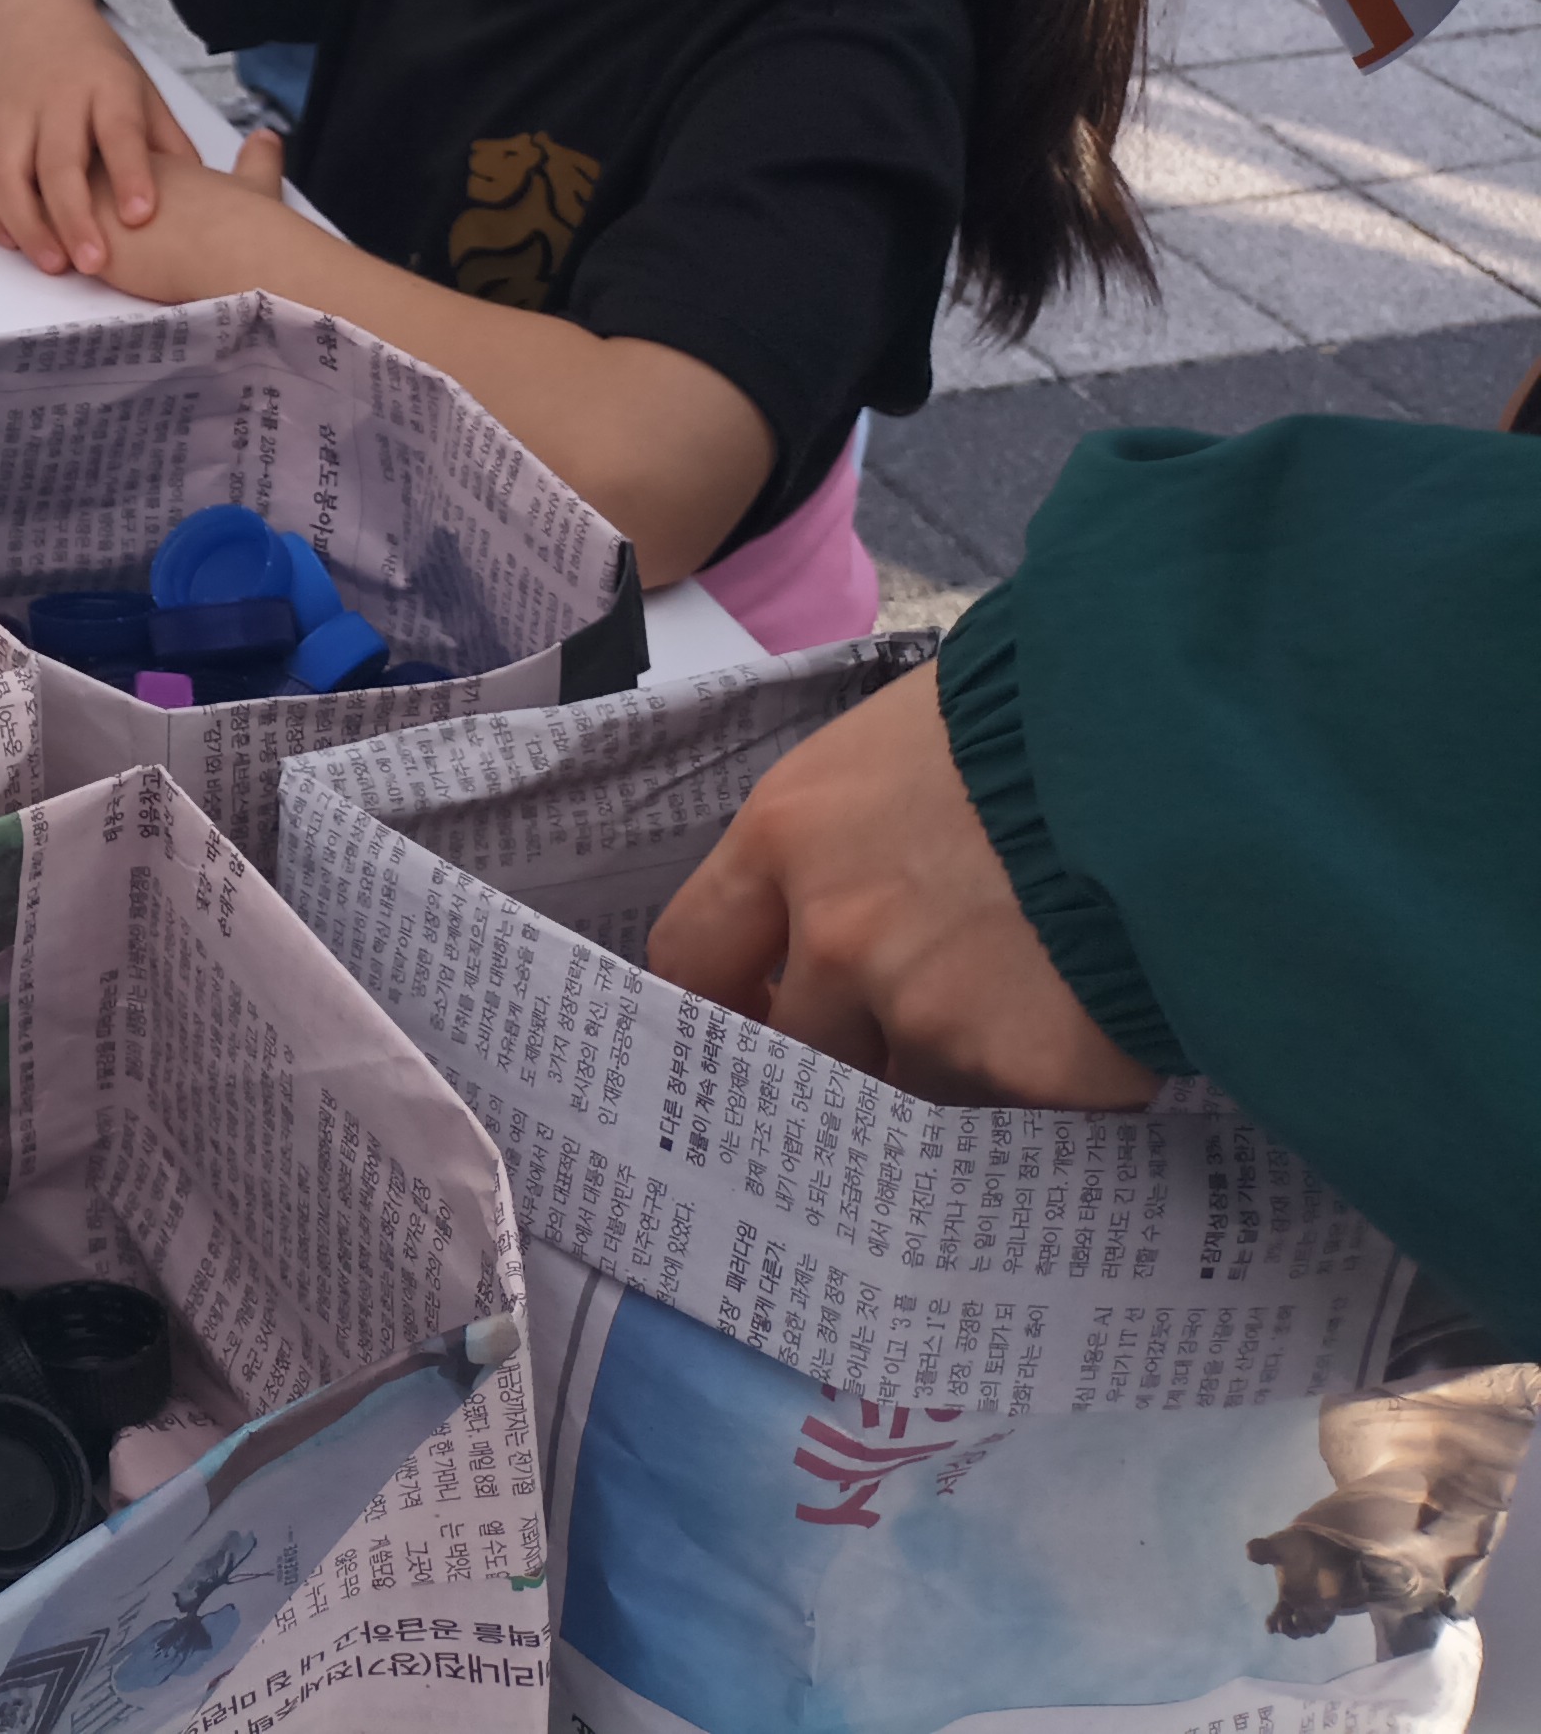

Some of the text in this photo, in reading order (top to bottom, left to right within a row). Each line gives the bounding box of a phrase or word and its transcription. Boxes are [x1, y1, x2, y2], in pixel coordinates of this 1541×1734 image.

[547, 943, 592, 1084] 3가지 성장전략을
[659, 1040, 693, 1136] 다른 정부의
[718, 1056, 752, 1165] 이는 단임제와
[685, 1078, 718, 1168] 장률이 계속
[750, 1119, 773, 1158] 구조
[780, 1118, 806, 1173] 어렵다.
[813, 1111, 842, 1167] 것들을
[582, 1149, 609, 1205] 대통령
[874, 1126, 908, 1217] 이해관계가
[602, 1163, 637, 1254] 더불어민주
[631, 1176, 668, 1267] 민주연구원
[1001, 1146, 1043, 1275] 우리나라의 정치
[725, 1219, 758, 1293] 패러다임
[398, 1479, 424, 1511] 가격
[432, 1457, 462, 1503] 가마니
[468, 1440, 500, 1499] 매일 8회
[300, 1650, 325, 1677] 내
[333, 1617, 463, 1653] 공급하고
[266, 1669, 292, 1698] 집
